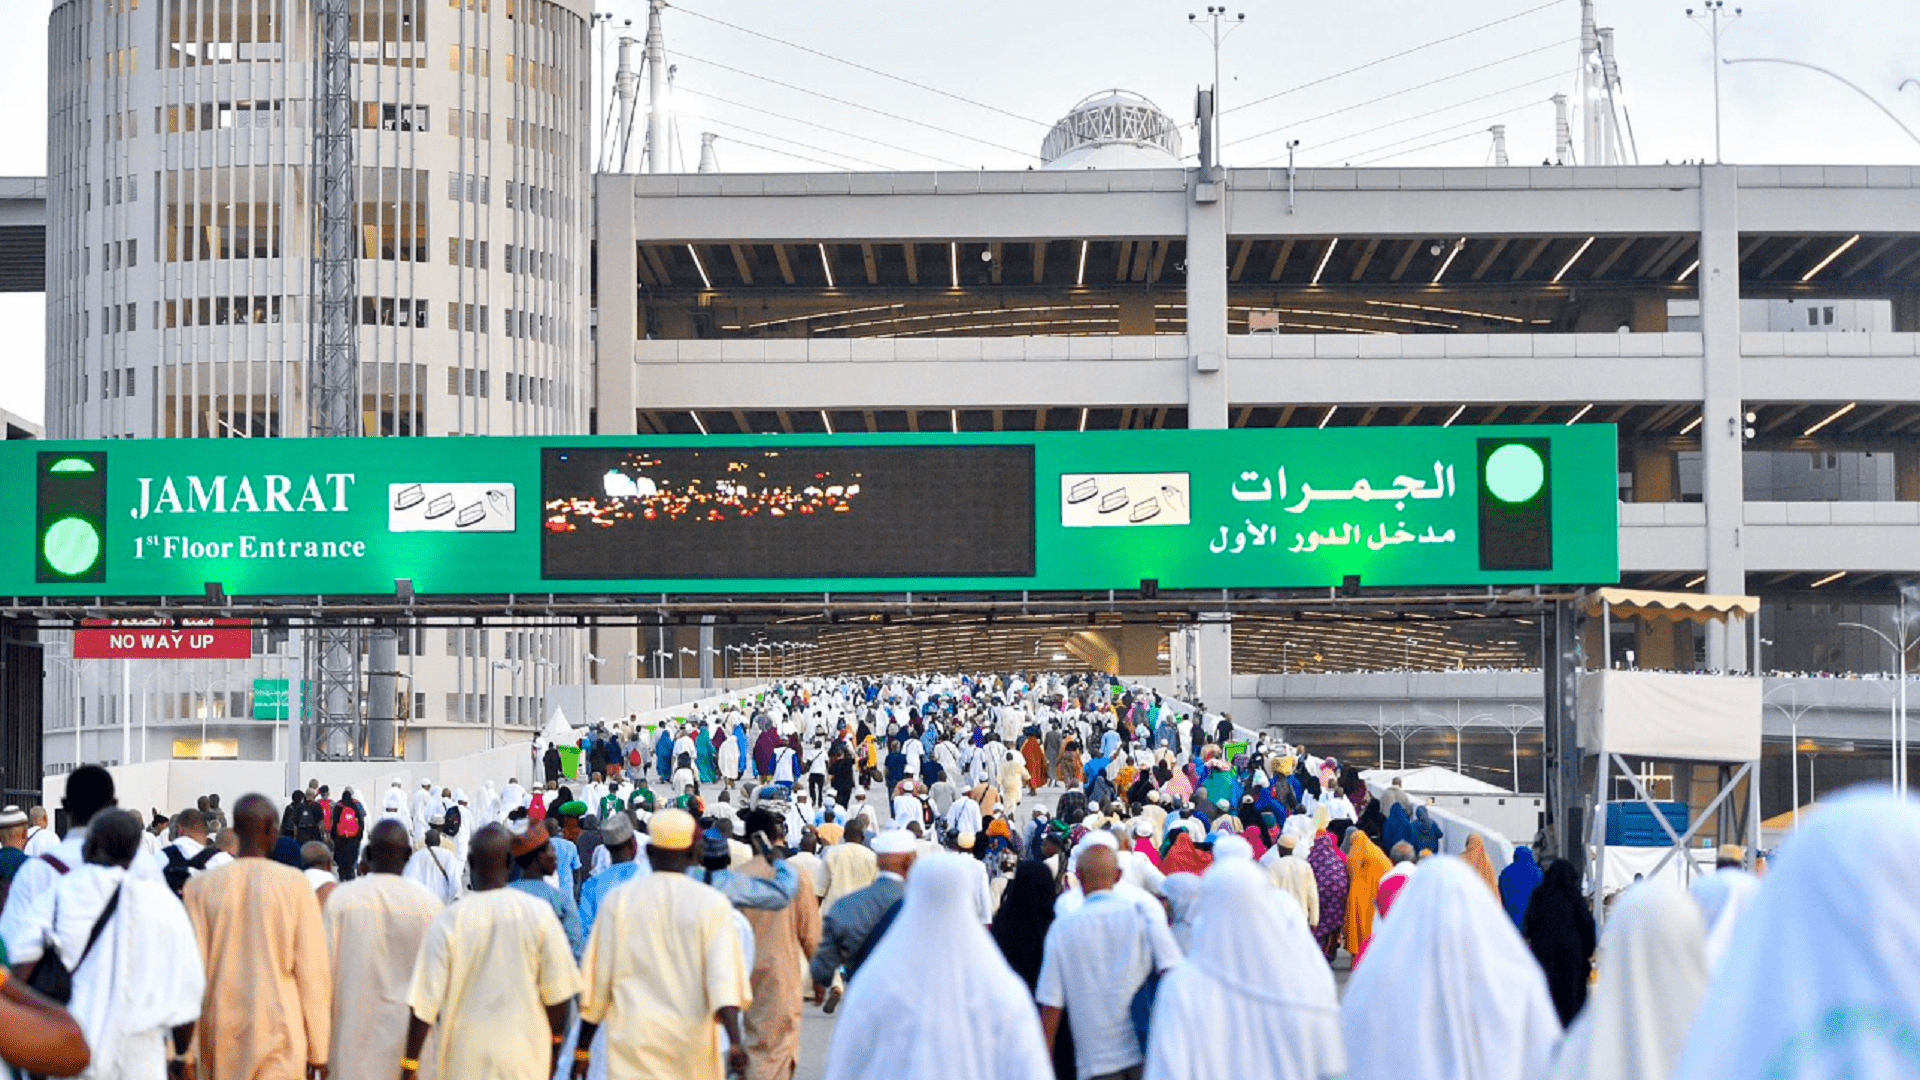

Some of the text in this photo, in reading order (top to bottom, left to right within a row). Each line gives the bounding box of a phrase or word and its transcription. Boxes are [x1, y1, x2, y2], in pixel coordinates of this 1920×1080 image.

[130, 474, 355, 519] JAMARAT
[1231, 460, 1456, 514] الجمرات
[163, 535, 234, 558] Floor
[239, 535, 366, 558] Entrance
[1209, 518, 1456, 554] مدخل الدور الأول
[110, 634, 214, 649] NO WAY UP
